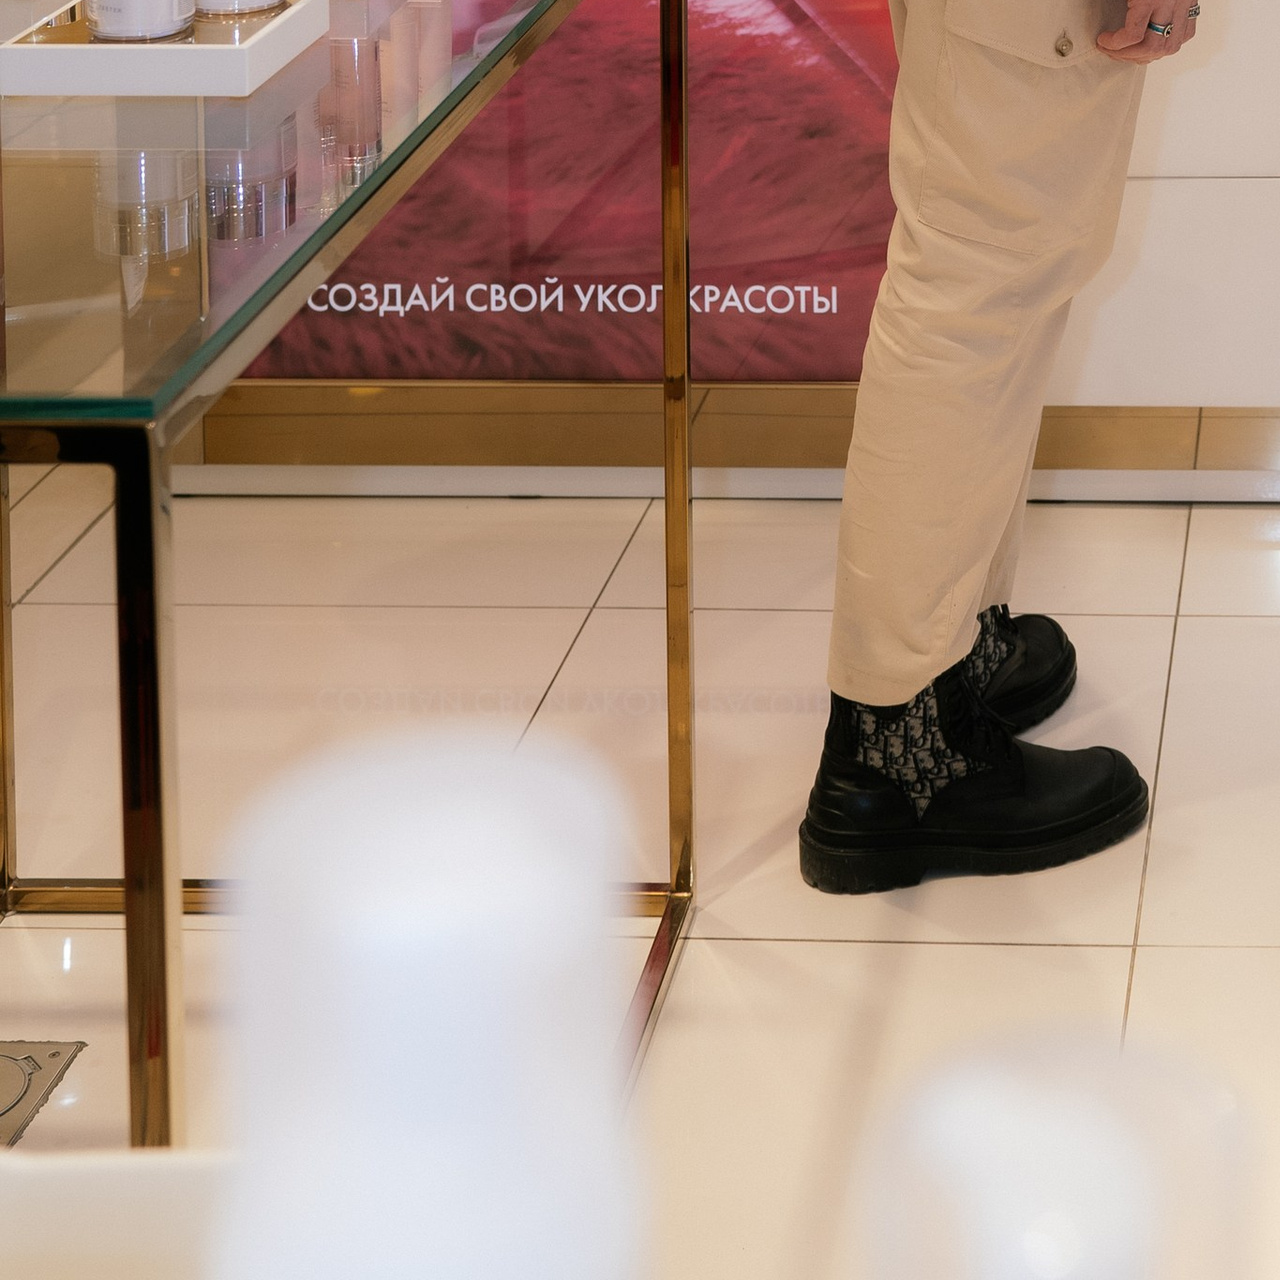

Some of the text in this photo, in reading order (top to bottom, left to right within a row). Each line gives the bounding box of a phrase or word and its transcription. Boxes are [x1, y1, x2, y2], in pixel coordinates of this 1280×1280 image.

[307, 276, 837, 318] СОЗДАЙ СВОЙ УКОЛ КРАСОТЫ
